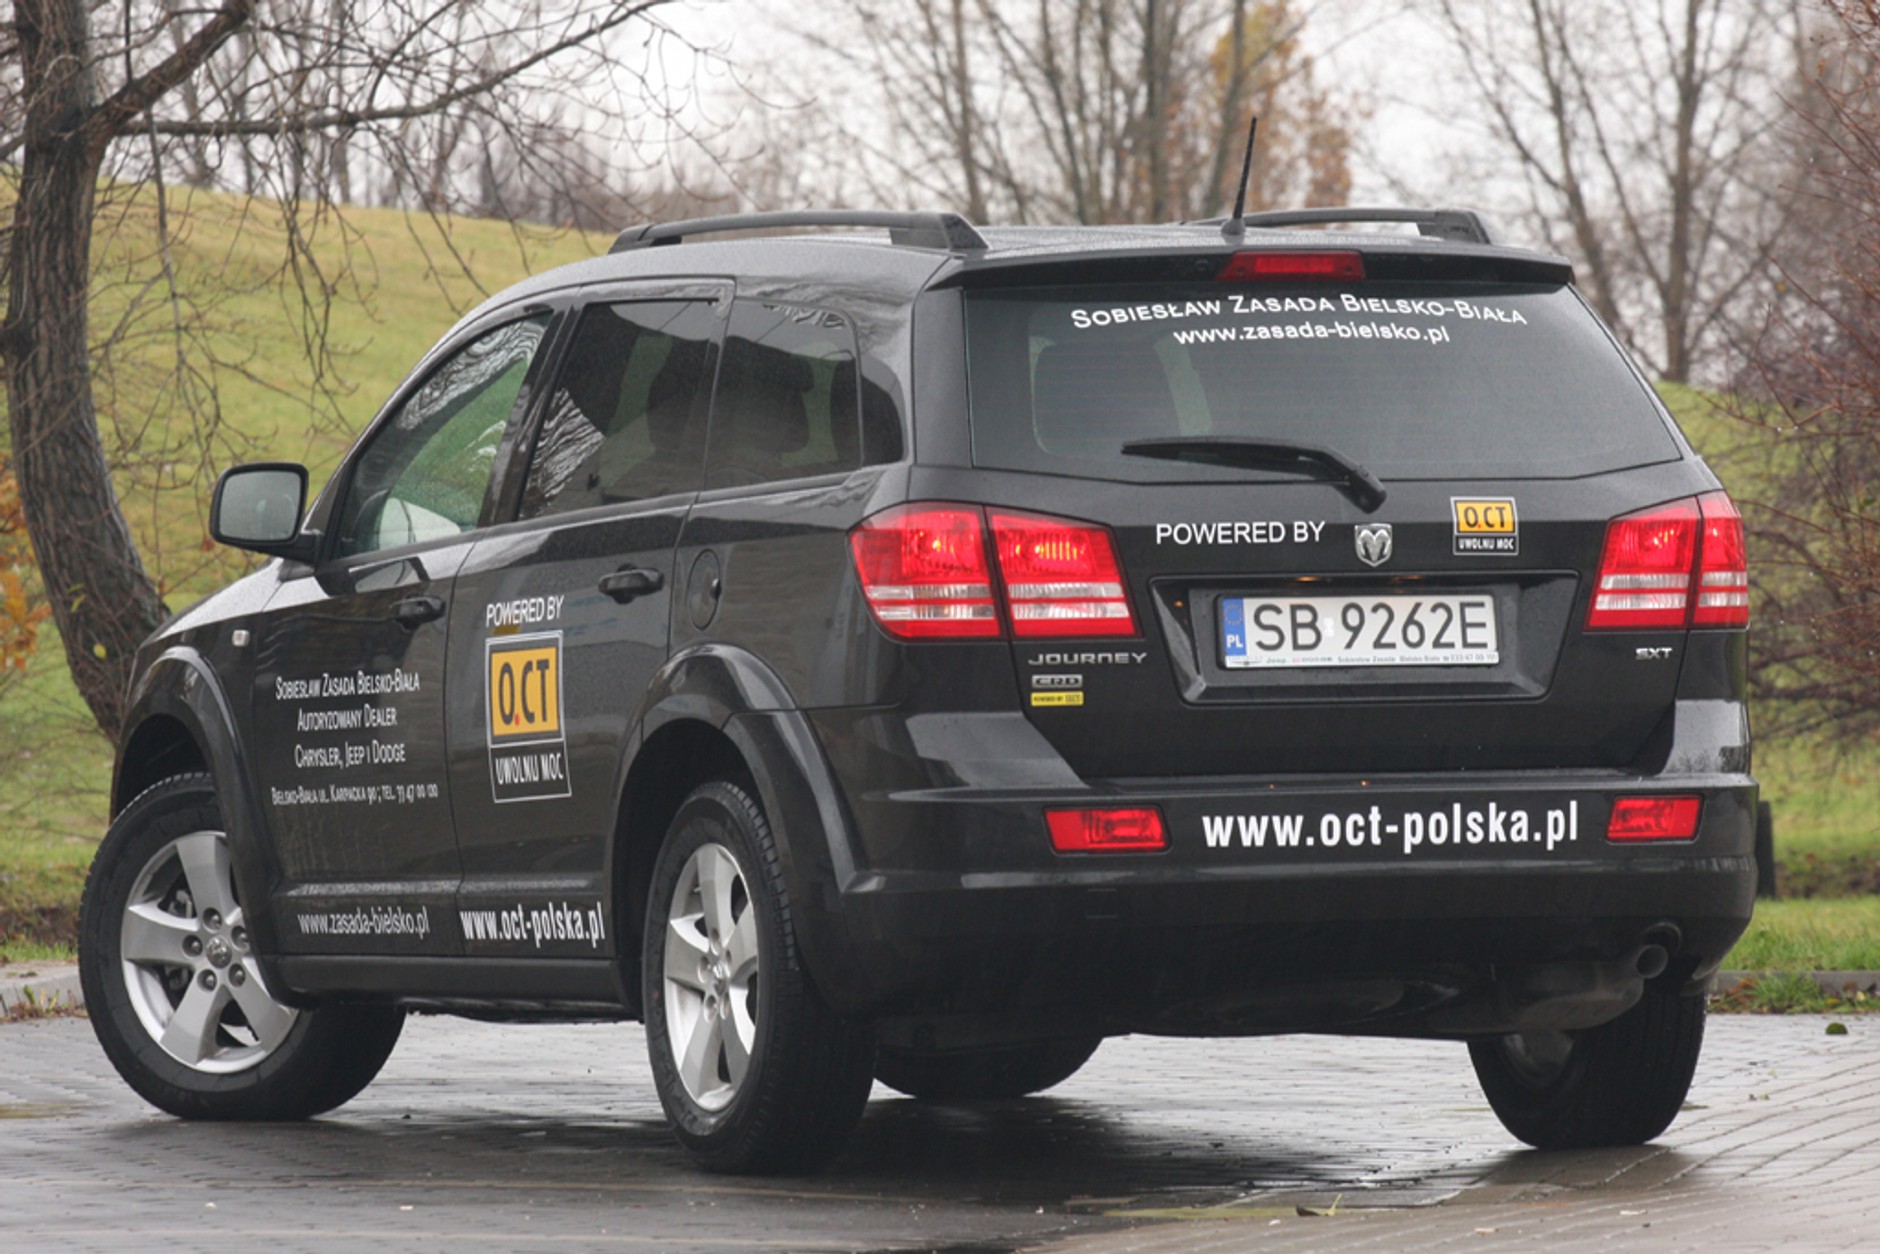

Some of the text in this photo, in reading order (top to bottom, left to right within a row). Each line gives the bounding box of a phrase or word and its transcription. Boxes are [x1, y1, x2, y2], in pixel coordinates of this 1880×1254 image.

[1071, 293, 1528, 330] SOBIESŁAW ZASADA BIELSKO-BIAŁA
[1173, 321, 1450, 346] www.zasada-bielsko.pl
[1156, 521, 1326, 545] POWERED BY
[486, 595, 564, 628] POWERED BY
[1253, 601, 1489, 651] SB 9262E
[1226, 635, 1244, 649] PL
[1635, 647, 1673, 660] SXT
[1028, 652, 1148, 666] JOURNEY
[322, 673, 355, 697] ZASADA
[357, 668, 420, 695] BIELSKO-BIAŁA
[1035, 676, 1080, 687] CRD
[297, 703, 398, 732] AUTORYZOWANY DEALER
[294, 744, 344, 770] CHRYSLER,
[344, 741, 365, 769] JEEP
[372, 739, 406, 764] DODGE
[540, 752, 564, 781] MOC
[1202, 800, 1578, 854] www.oct-polska.pl
[298, 906, 430, 939] www.zasada-bielsko.pl
[460, 902, 605, 948] www.oct-polska.pl
